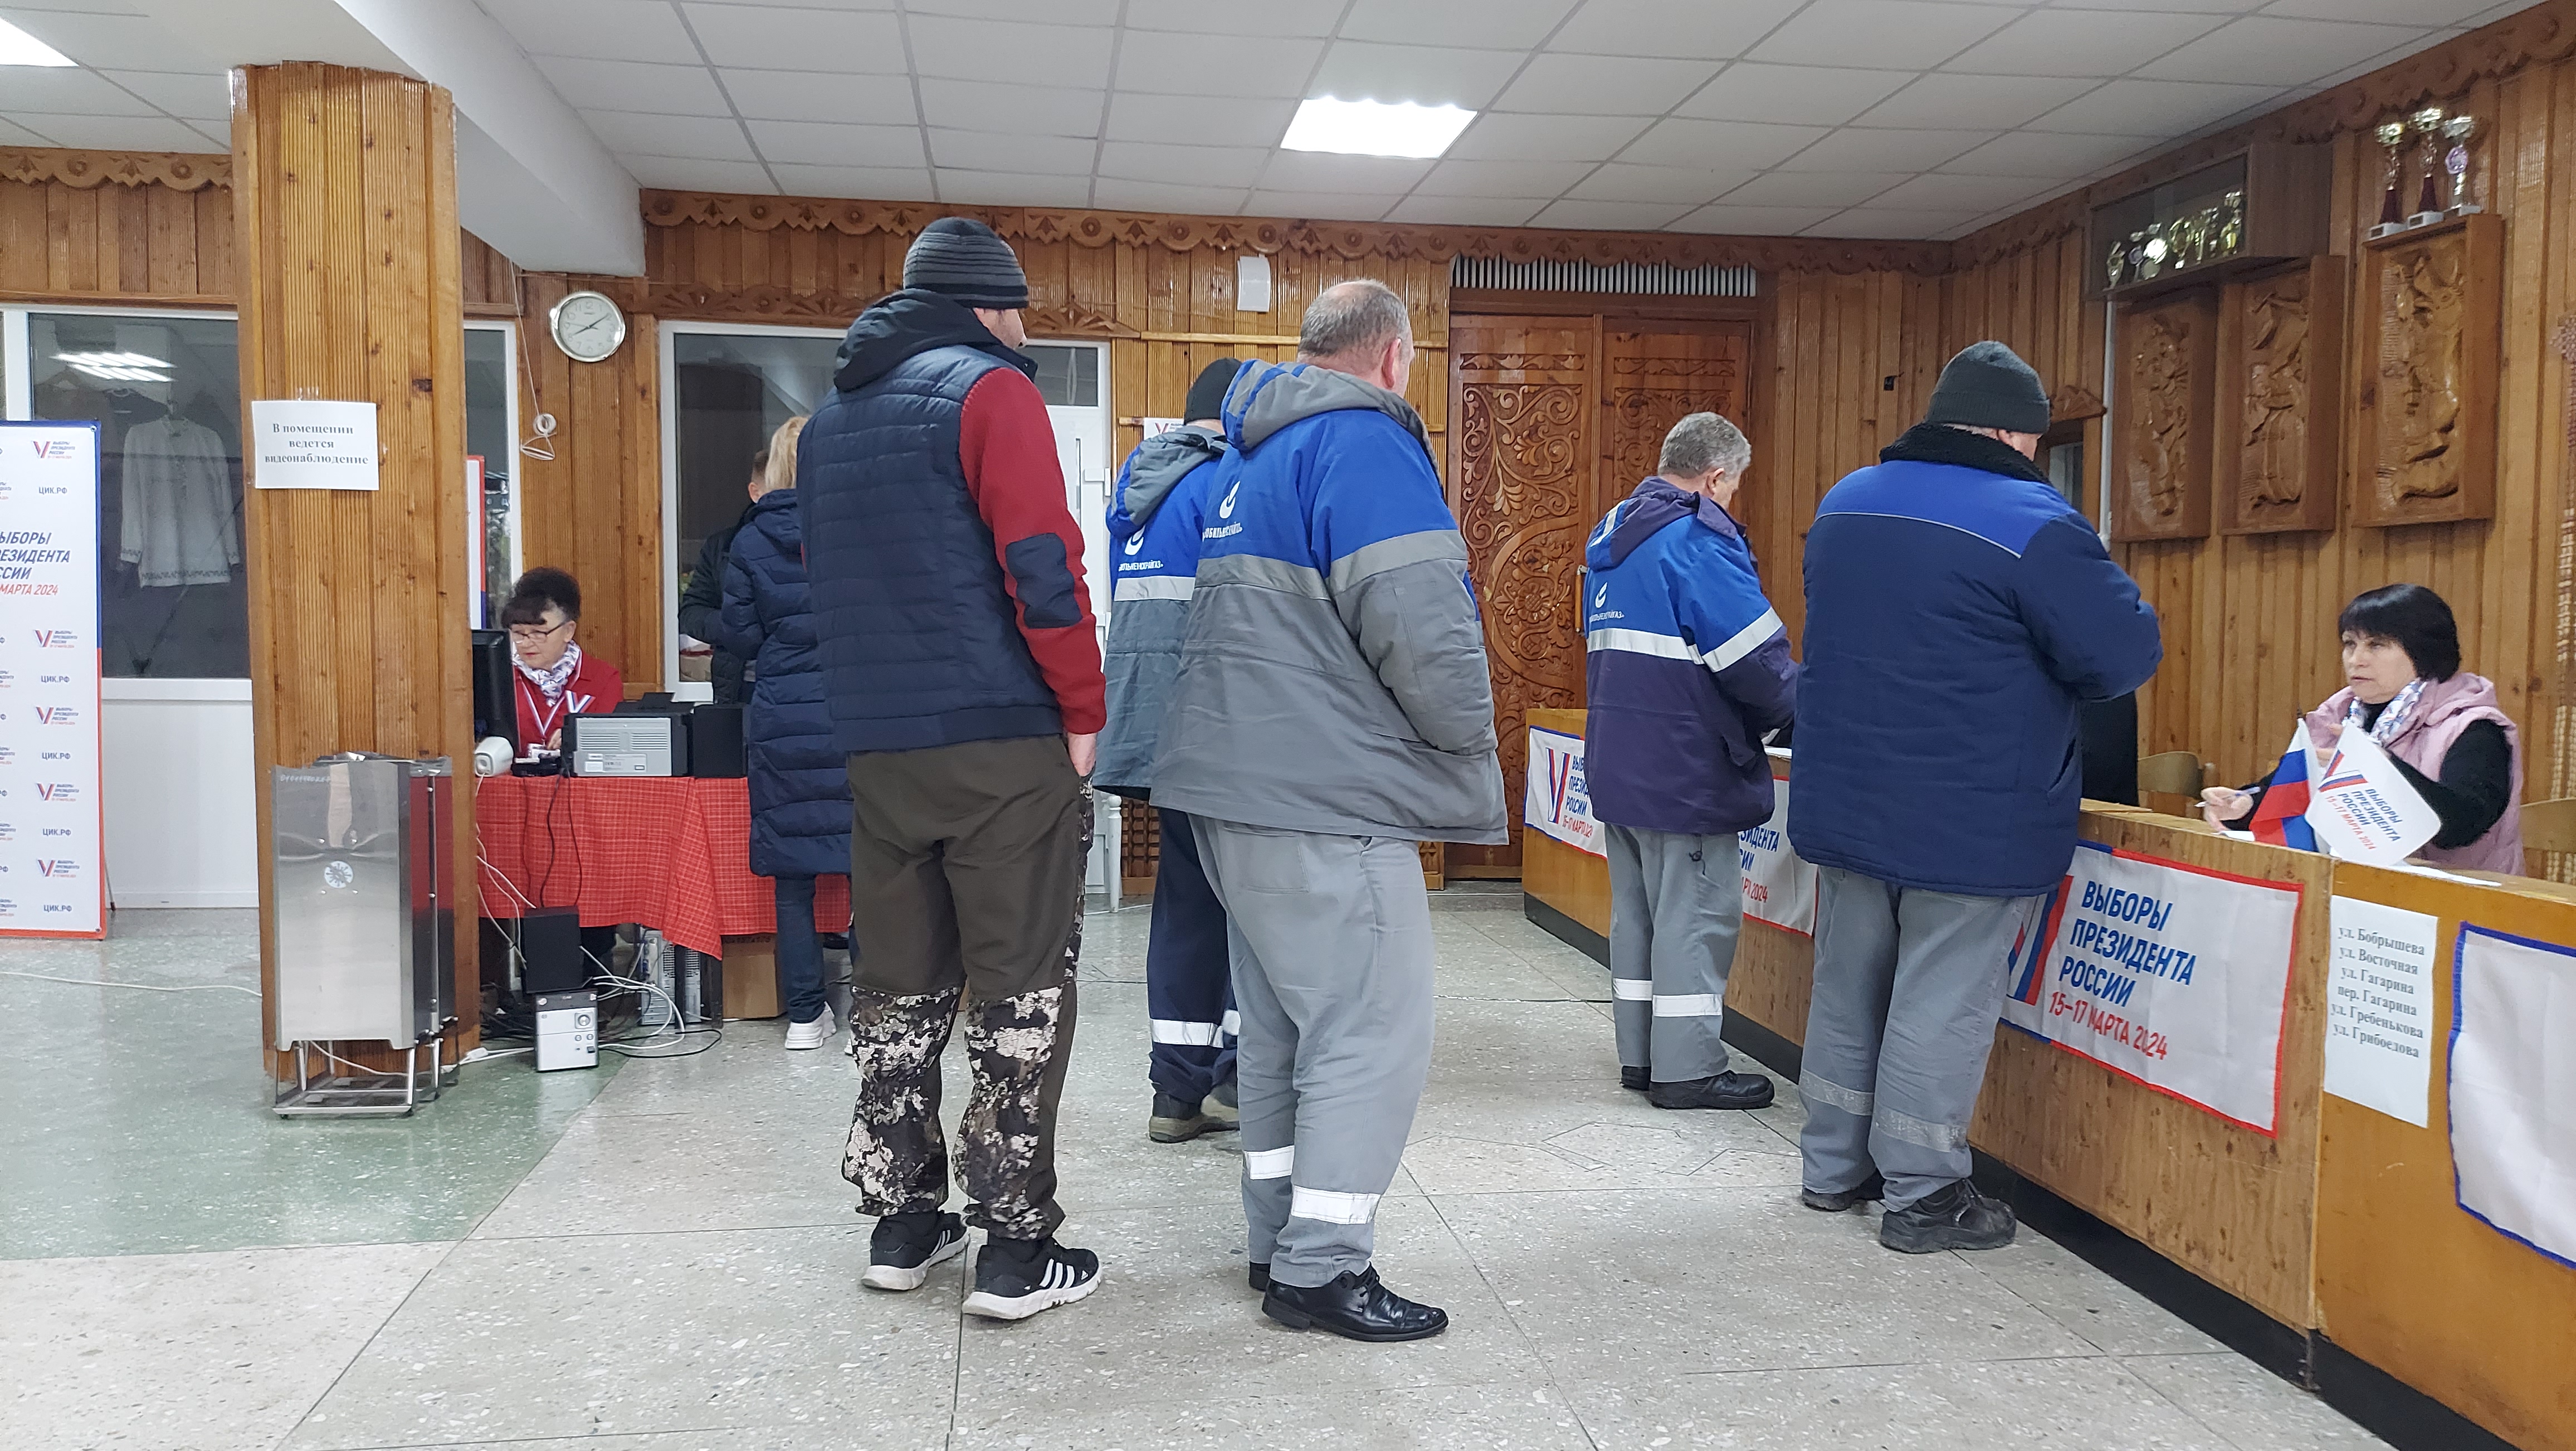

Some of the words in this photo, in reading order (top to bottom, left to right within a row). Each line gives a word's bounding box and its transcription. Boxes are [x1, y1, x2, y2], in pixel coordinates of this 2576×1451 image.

[272, 423, 280, 434] В
[283, 425, 354, 435] помещении
[265, 453, 369, 465] видеонаблюдение
[38, 486, 68, 495] ЦИК.РФ
[0, 531, 52, 545] ЫБОРЫ
[0, 548, 71, 564] ЕЗИДЕНТА
[33, 584, 59, 596] 2024
[42, 752, 71, 760] ЦИК.РФ
[1572, 755, 1584, 772] ВЫБ
[1568, 775, 1589, 798] ПРЕЗИД
[2337, 793, 2372, 825] РОССИИ
[2351, 791, 2401, 841] ПРЕЗИДЕНТА
[2365, 788, 2403, 823] ВЫБОРЫ
[1739, 826, 1780, 853] ЗИДЕНТА
[1751, 883, 1768, 903] 2024
[2081, 880, 2173, 931] ВЫБОРЫ
[43, 904, 73, 913] ЦИК.РФ
[2070, 918, 2197, 986] ПРЕЗИДЕНТА
[2338, 927, 2355, 939] ул.
[2358, 928, 2425, 955] Бобрышева
[2339, 947, 2355, 959] ул.
[2359, 948, 2418, 975] Восточная
[2058, 956, 2136, 1007] РОССИИ
[2340, 967, 2357, 980] ул.
[2360, 968, 2414, 994] Гагарина
[2338, 986, 2360, 1001] пер.
[2362, 989, 2417, 1016] Гагарина
[2087, 1005, 2130, 1045] МАРТА
[2330, 1004, 2347, 1016] ул.
[2350, 1005, 2423, 1039] Гребенькова
[2333, 1024, 2349, 1036] ул.
[2352, 1026, 2419, 1058] Грибоедова
